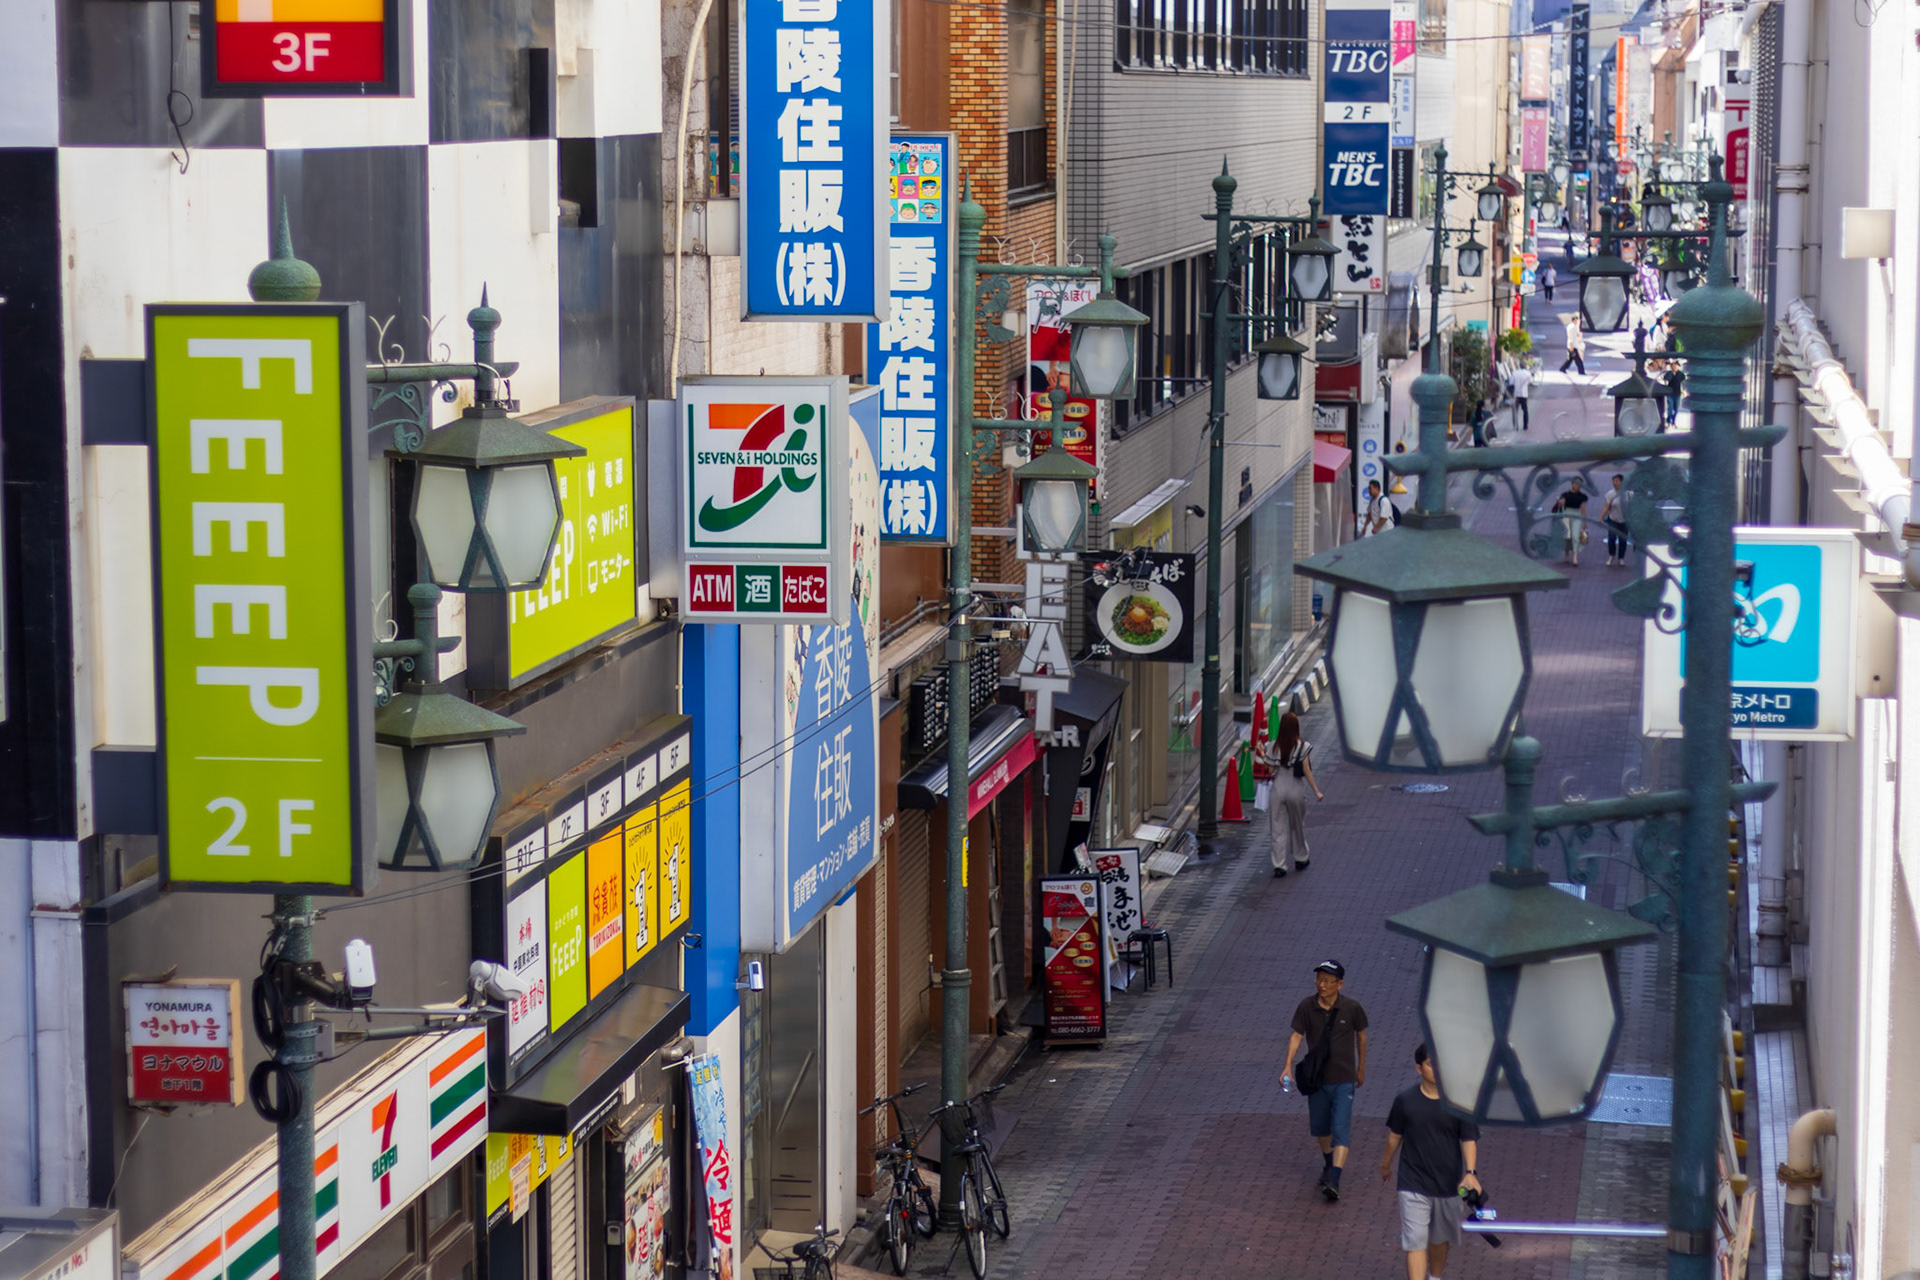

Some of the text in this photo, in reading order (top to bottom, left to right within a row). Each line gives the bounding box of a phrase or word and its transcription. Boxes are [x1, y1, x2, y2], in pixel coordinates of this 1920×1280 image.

[272, 32, 331, 73] 3F
[1329, 50, 1388, 73] TBC
[1337, 152, 1377, 164] MEN'S
[1328, 164, 1384, 187] TBC
[1034, 289, 1095, 303] アロ&ほぐし
[879, 236, 938, 535] 香陵住販(株)
[754, 452, 818, 466] HOLDINGS
[188, 338, 320, 726] FEEEP
[602, 504, 628, 537] Wi-Fi
[601, 552, 631, 584] モニター
[692, 574, 825, 604] ATM 酒 たばこ
[1016, 553, 1076, 732] EAT
[814, 621, 852, 727] 香陵
[1730, 693, 1791, 709] 京メトロ
[1731, 711, 1786, 724] yo Metro
[670, 744, 679, 770] 5F
[635, 767, 646, 792] 4F
[814, 723, 852, 843] 住販
[600, 791, 610, 818] 3F
[561, 815, 571, 845] 2F
[517, 840, 534, 874] B1F
[552, 924, 582, 981] FEEEP
[145, 1002, 213, 1013] YONAMURA
[140, 1017, 221, 1041] 연아마을
[142, 1055, 224, 1072] ヨナマウル
[162, 1079, 203, 1091] 地下1階
